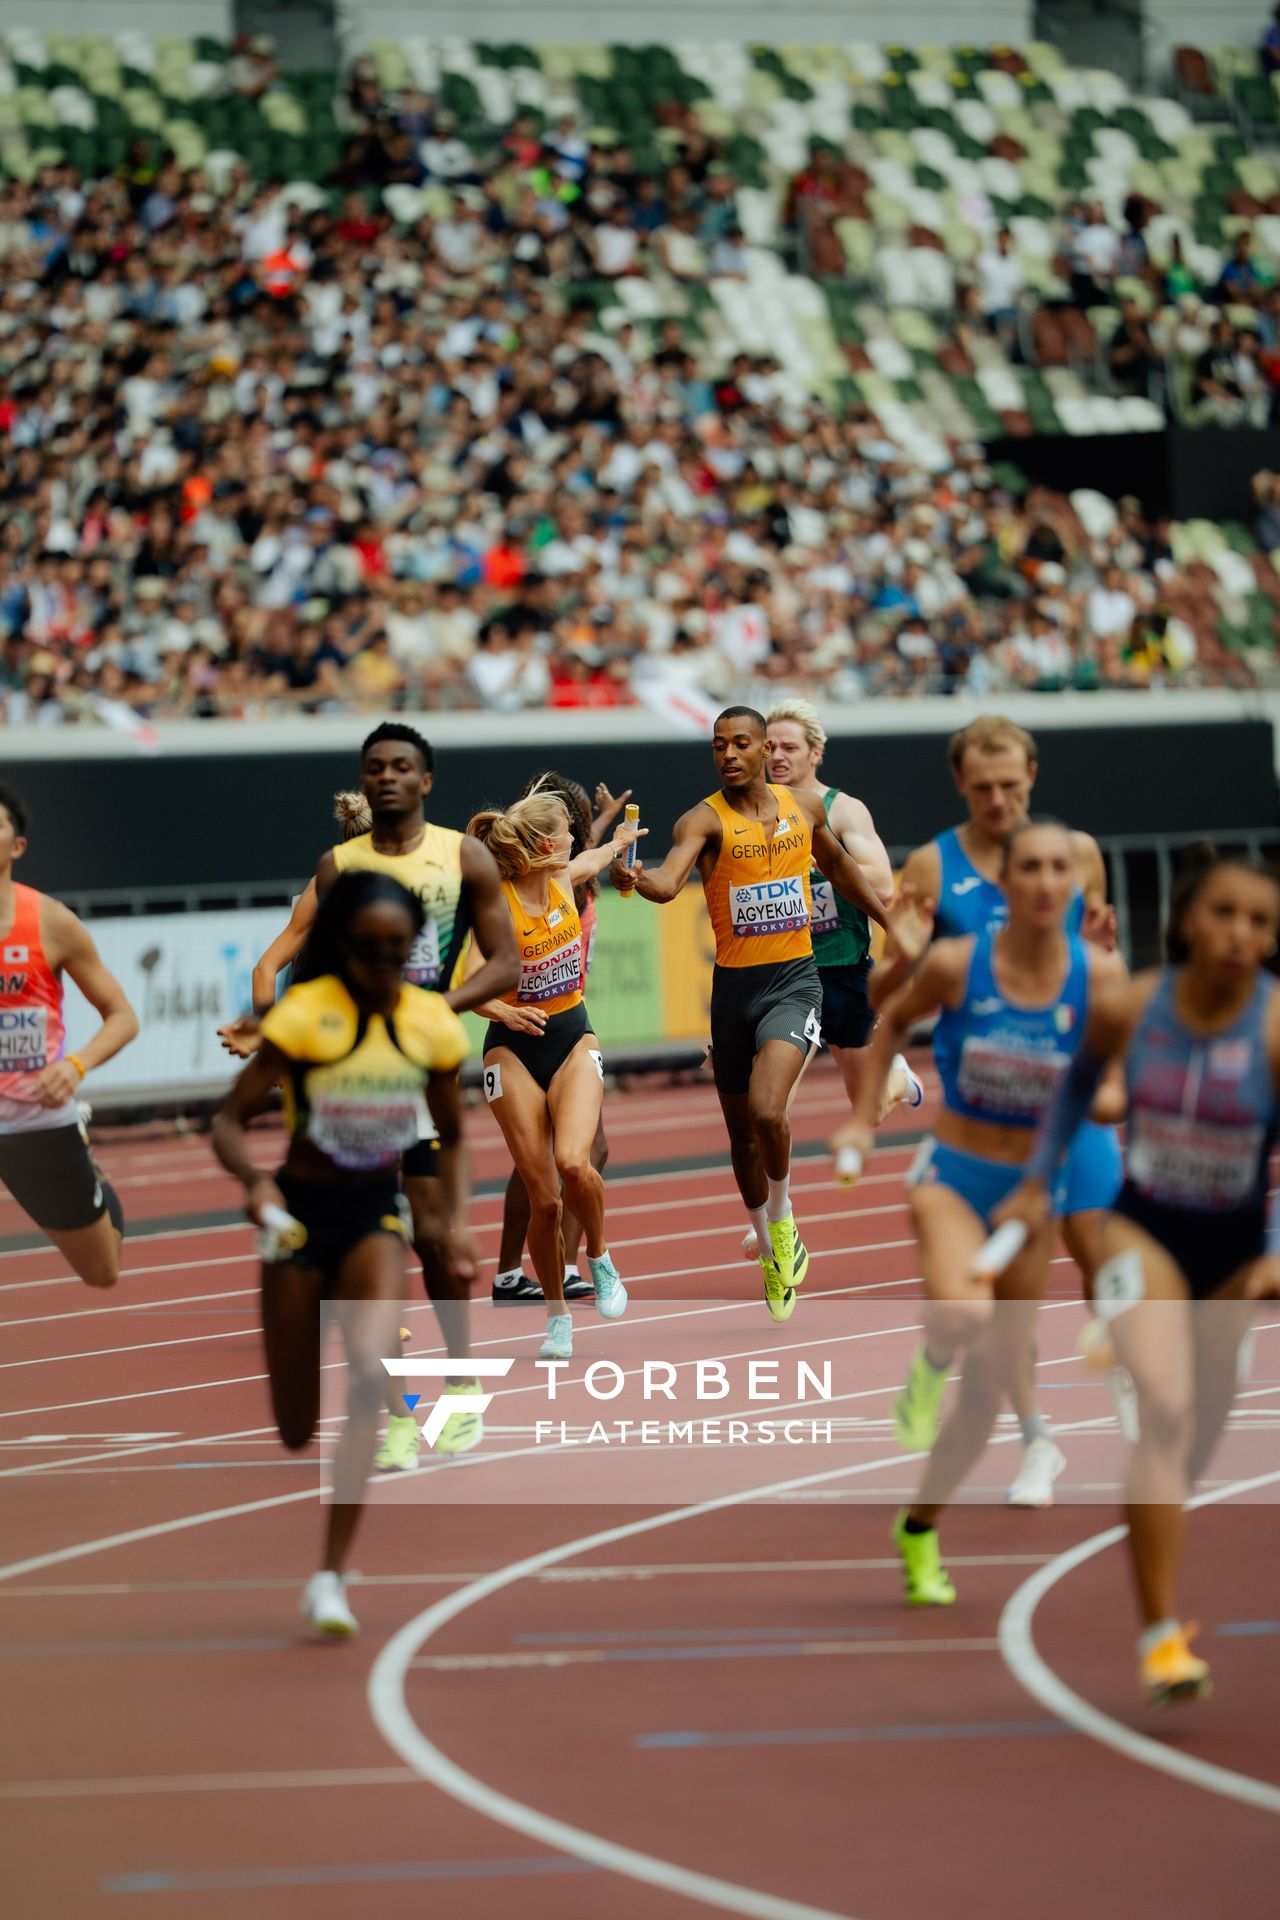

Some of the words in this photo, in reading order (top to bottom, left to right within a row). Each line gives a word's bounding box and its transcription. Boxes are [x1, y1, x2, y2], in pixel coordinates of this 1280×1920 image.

[732, 833, 804, 858] GERMANY
[750, 878, 799, 901] TDK
[736, 898, 805, 923] AGYEKUM
[523, 922, 577, 958] GERMANY
[522, 943, 580, 974] HONDA
[486, 1071, 495, 1096] 9
